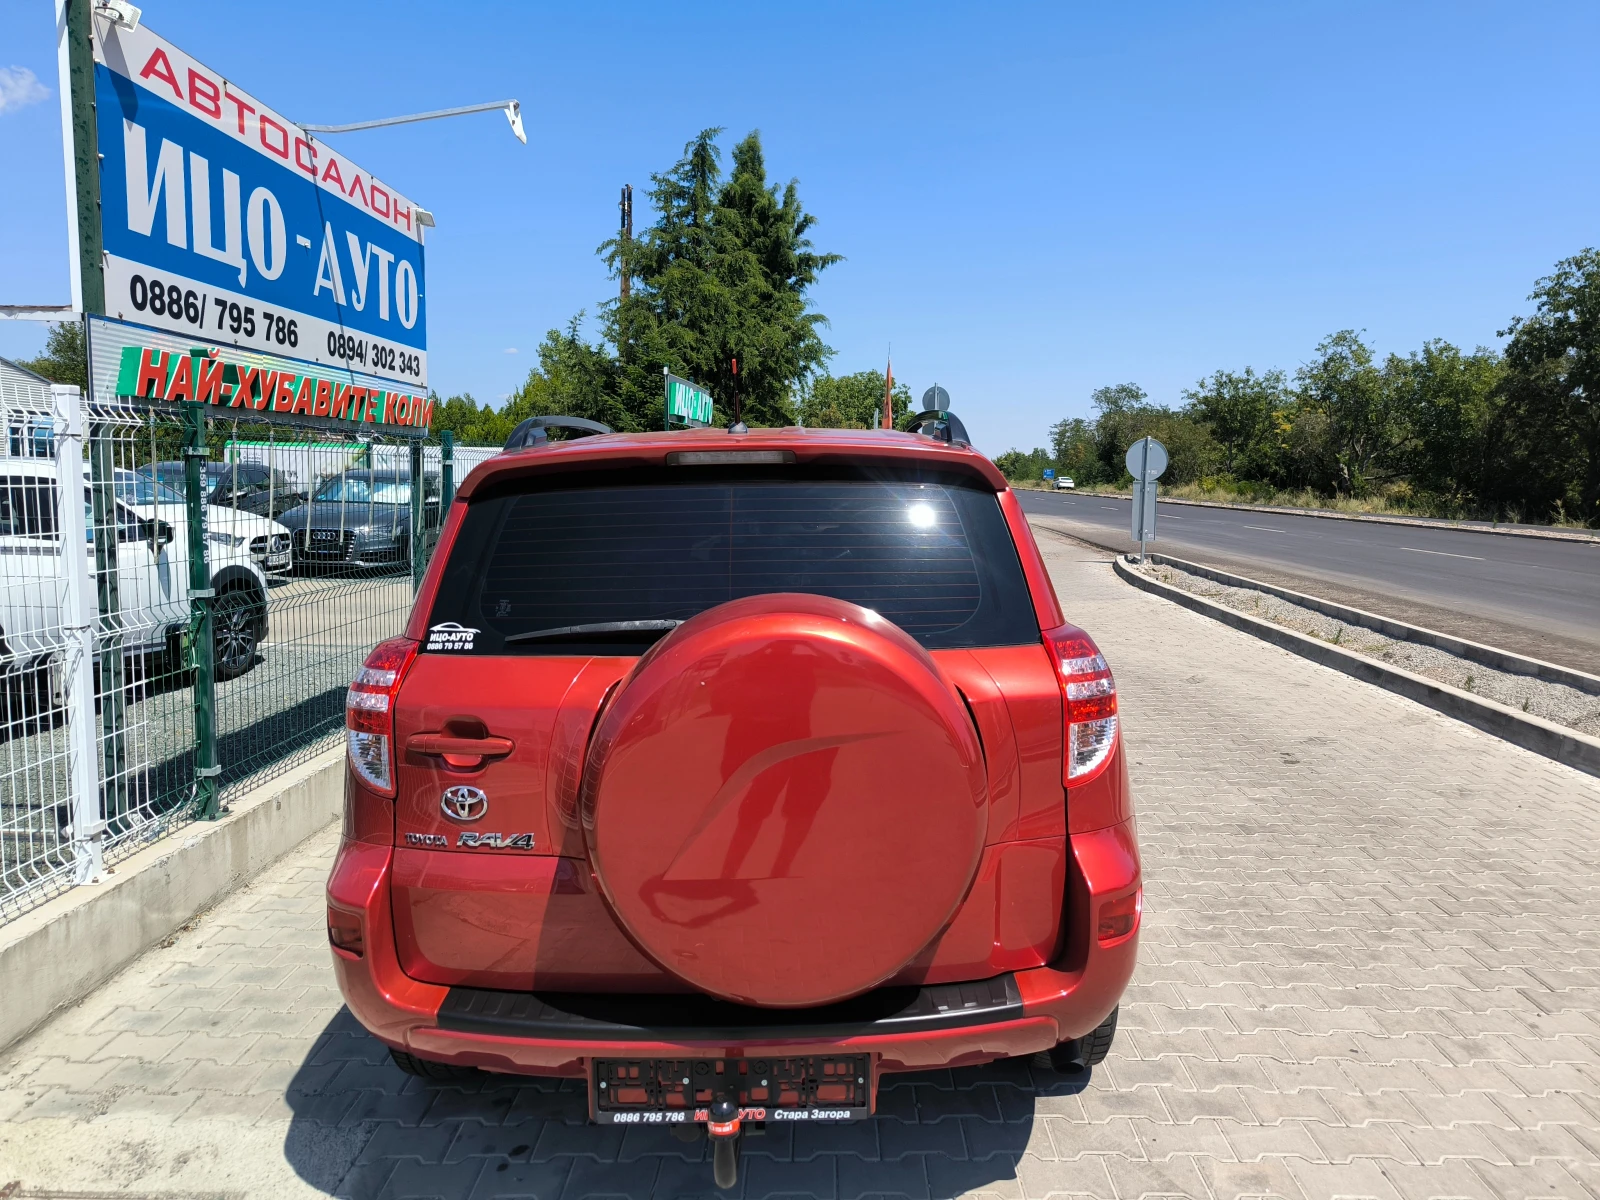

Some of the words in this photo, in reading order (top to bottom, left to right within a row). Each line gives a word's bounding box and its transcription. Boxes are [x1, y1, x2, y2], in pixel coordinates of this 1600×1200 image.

[139, 47, 411, 231] АВТОСАЛОН
[129, 274, 207, 329] 0886/
[214, 297, 256, 338] 795
[262, 312, 299, 348] 786
[327, 331, 369, 367] 0894/
[371, 343, 396, 372] 302
[399, 351, 420, 377] 343
[135, 347, 379, 424] НАЙ-ХУБАВИТЕ
[384, 390, 434, 428] КОЛИ
[200, 491, 208, 511] 886
[201, 515, 208, 529] 79
[430, 632, 474, 642] ИЦО-АУТО
[444, 642, 453, 650] 79
[454, 642, 463, 650] 57
[464, 642, 474, 650] 86
[405, 832, 448, 846] TOYOTA
[456, 831, 535, 849] RAV4
[613, 1112, 640, 1123] 0886
[642, 1112, 662, 1122] 795
[665, 1111, 685, 1122] 786
[774, 1109, 809, 1120] Стара
[811, 1108, 851, 1120] Загора
